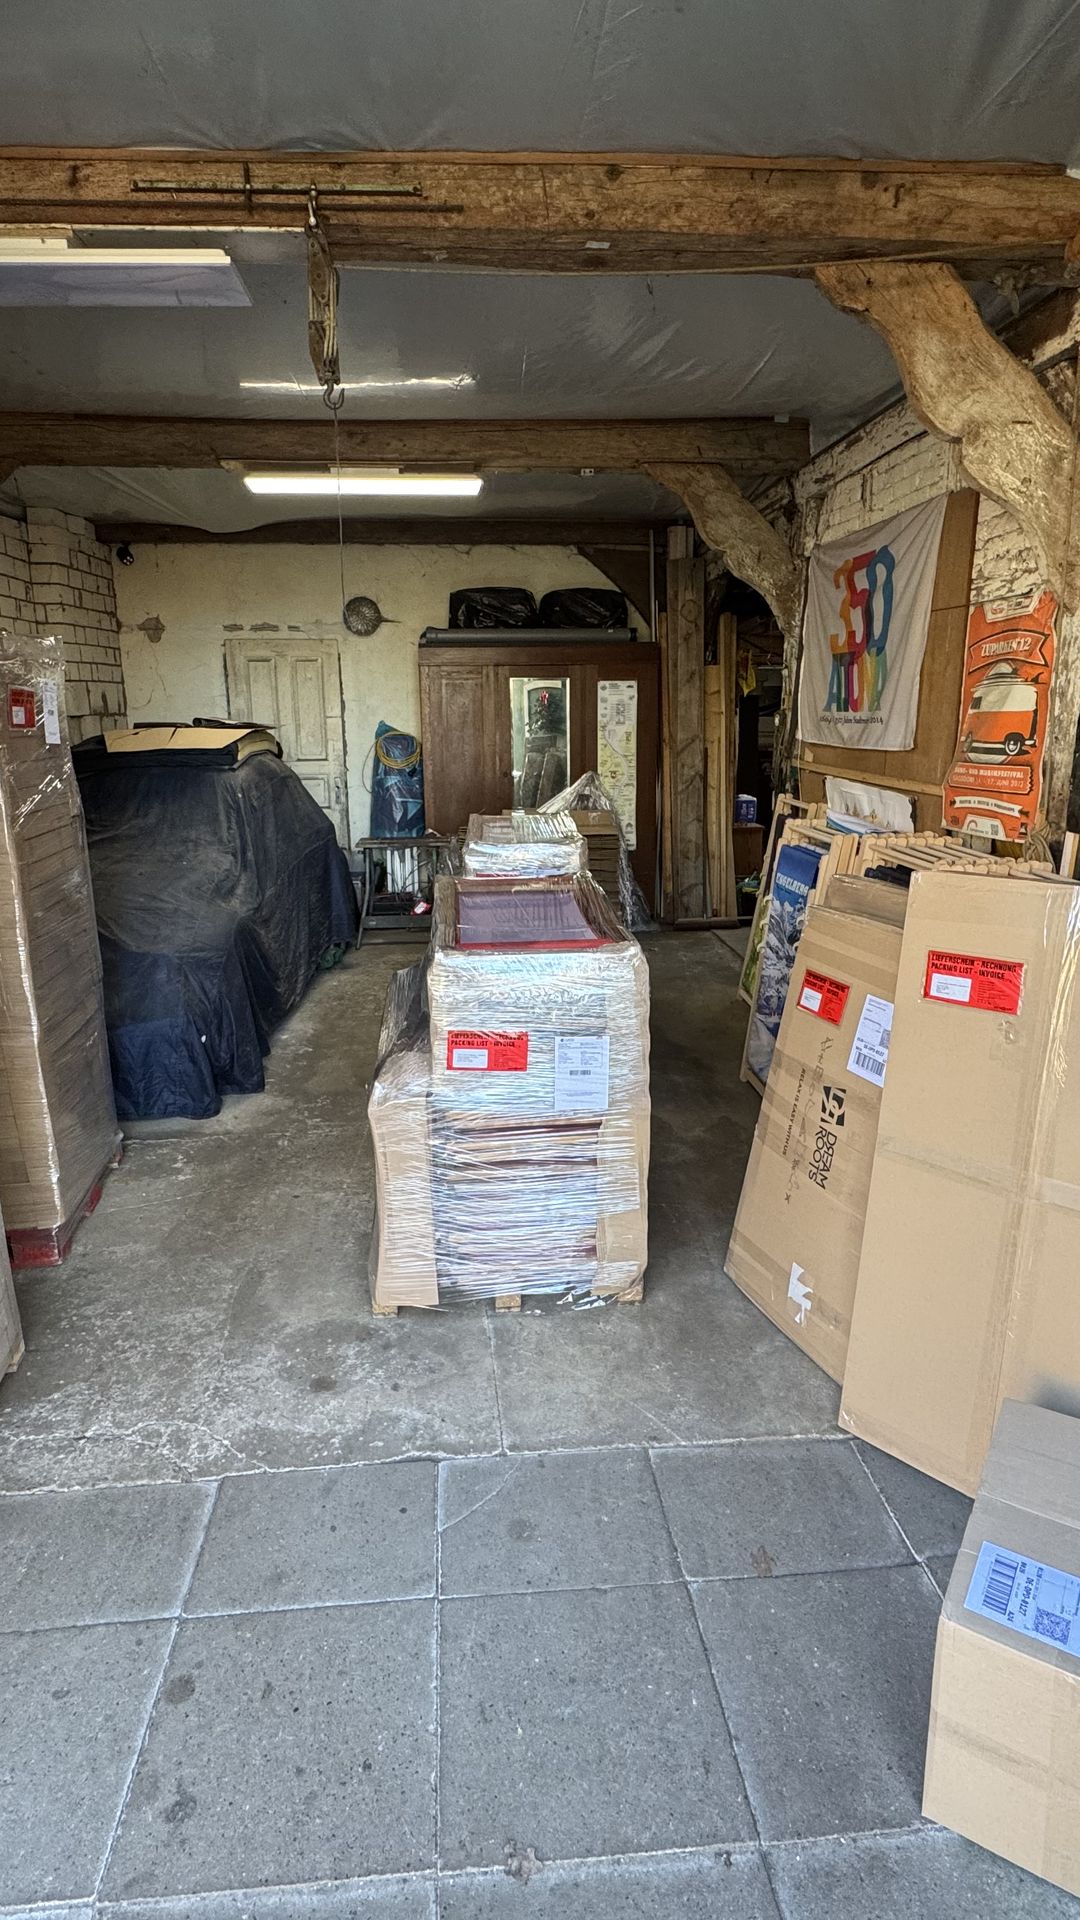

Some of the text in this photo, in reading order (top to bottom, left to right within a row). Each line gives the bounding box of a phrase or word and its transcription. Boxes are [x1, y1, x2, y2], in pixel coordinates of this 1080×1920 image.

[931, 954, 975, 967] LIEFERSCHEIN
[981, 961, 1017, 973] RECHNUNG
[931, 962, 958, 972] PACKING
[959, 965, 973, 975] LIST
[979, 969, 1005, 980] INVOICE
[796, 1067, 806, 1093] RELAX
[789, 1103, 798, 1124] EASY
[785, 1124, 793, 1144] WITH
[808, 1125, 828, 1182] ROOTS
